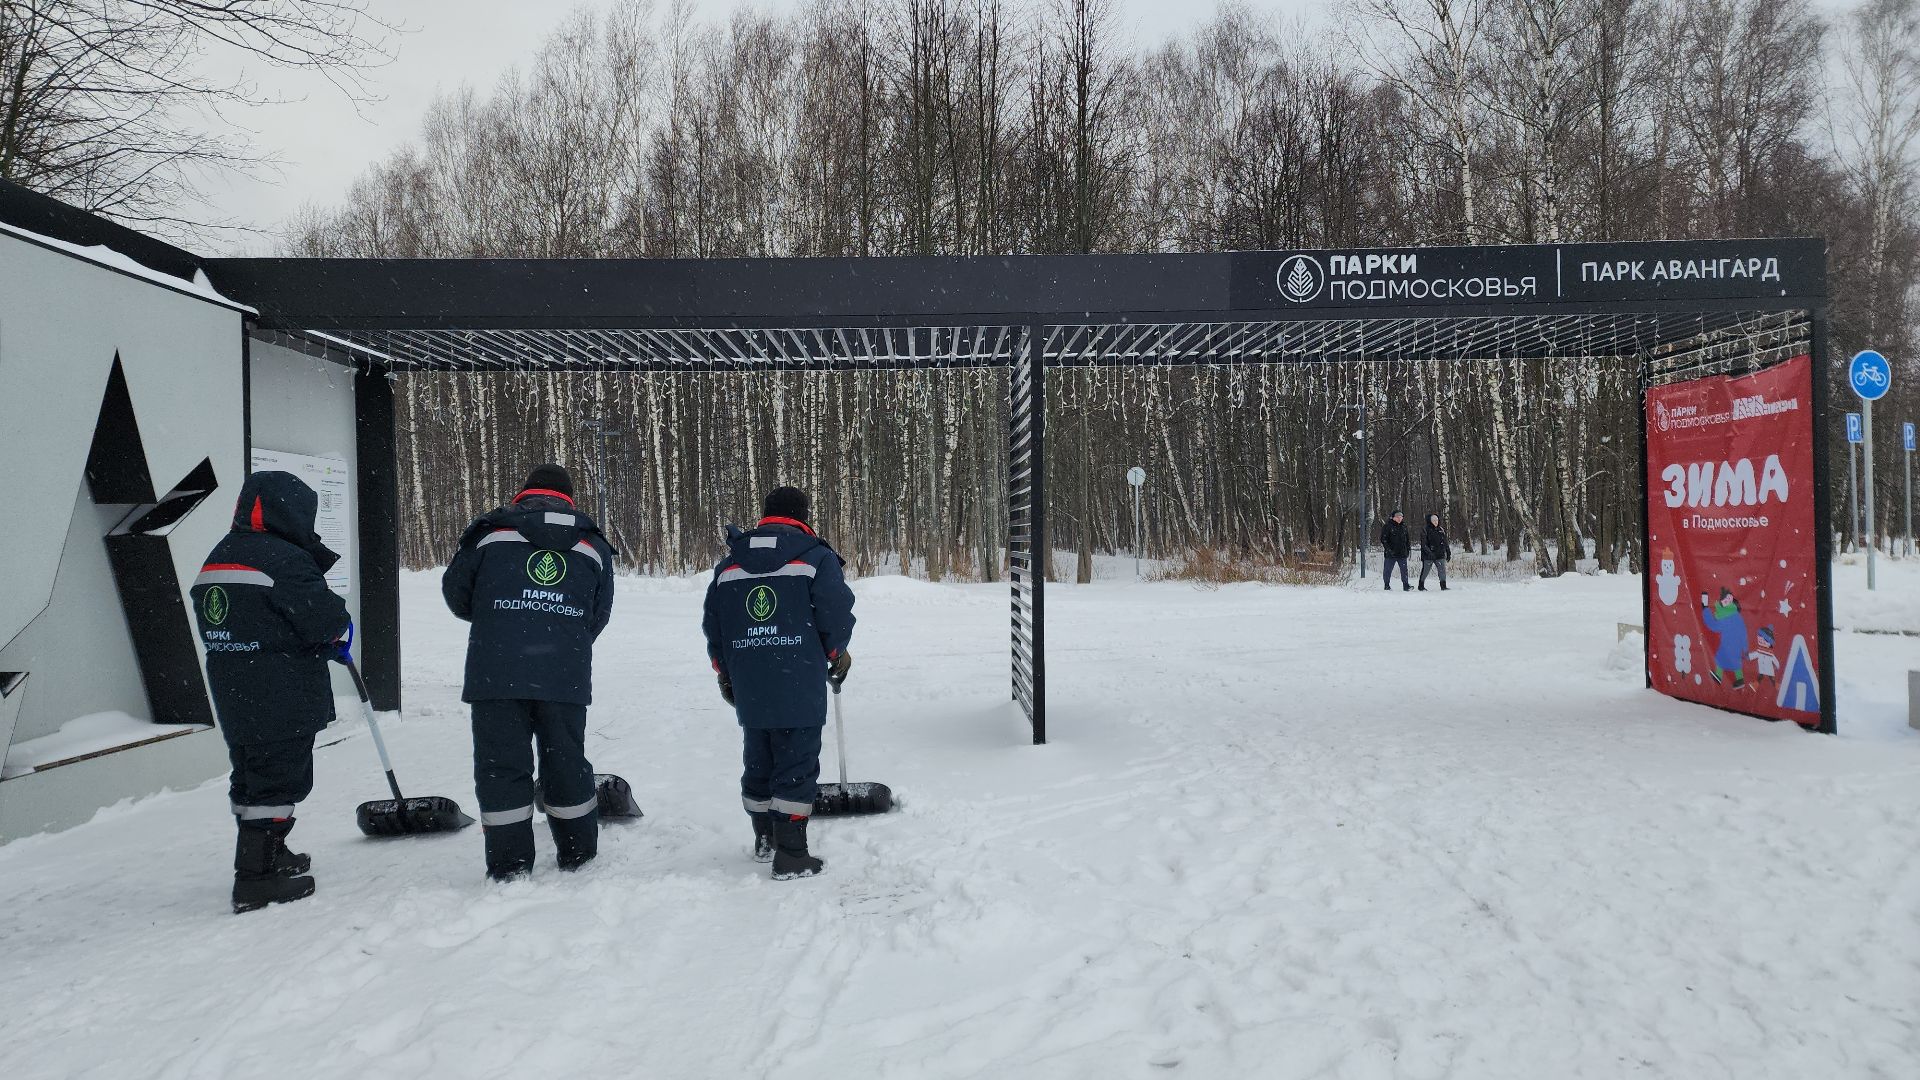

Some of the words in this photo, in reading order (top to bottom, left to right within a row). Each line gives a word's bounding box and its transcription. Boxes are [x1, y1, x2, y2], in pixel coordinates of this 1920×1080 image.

[1330, 254, 1417, 275] ПАРКИ
[1582, 261, 1646, 281] ПАРК
[1652, 257, 1780, 281] АВАНГАРД
[1330, 276, 1536, 300] ПОДМОСКОВЬЯ
[1671, 405, 1697, 417] ПАРКИ
[1671, 412, 1729, 428] ПОДМОСКОВЬЯ
[1662, 455, 1789, 507] ЗИМА
[1683, 518, 1689, 528] в
[1692, 514, 1769, 530] Подмосковье
[522, 589, 564, 602] ПАРКИ
[493, 599, 584, 617] ПОДМОСКОВЬЯ
[747, 625, 777, 637] ПАРКИ
